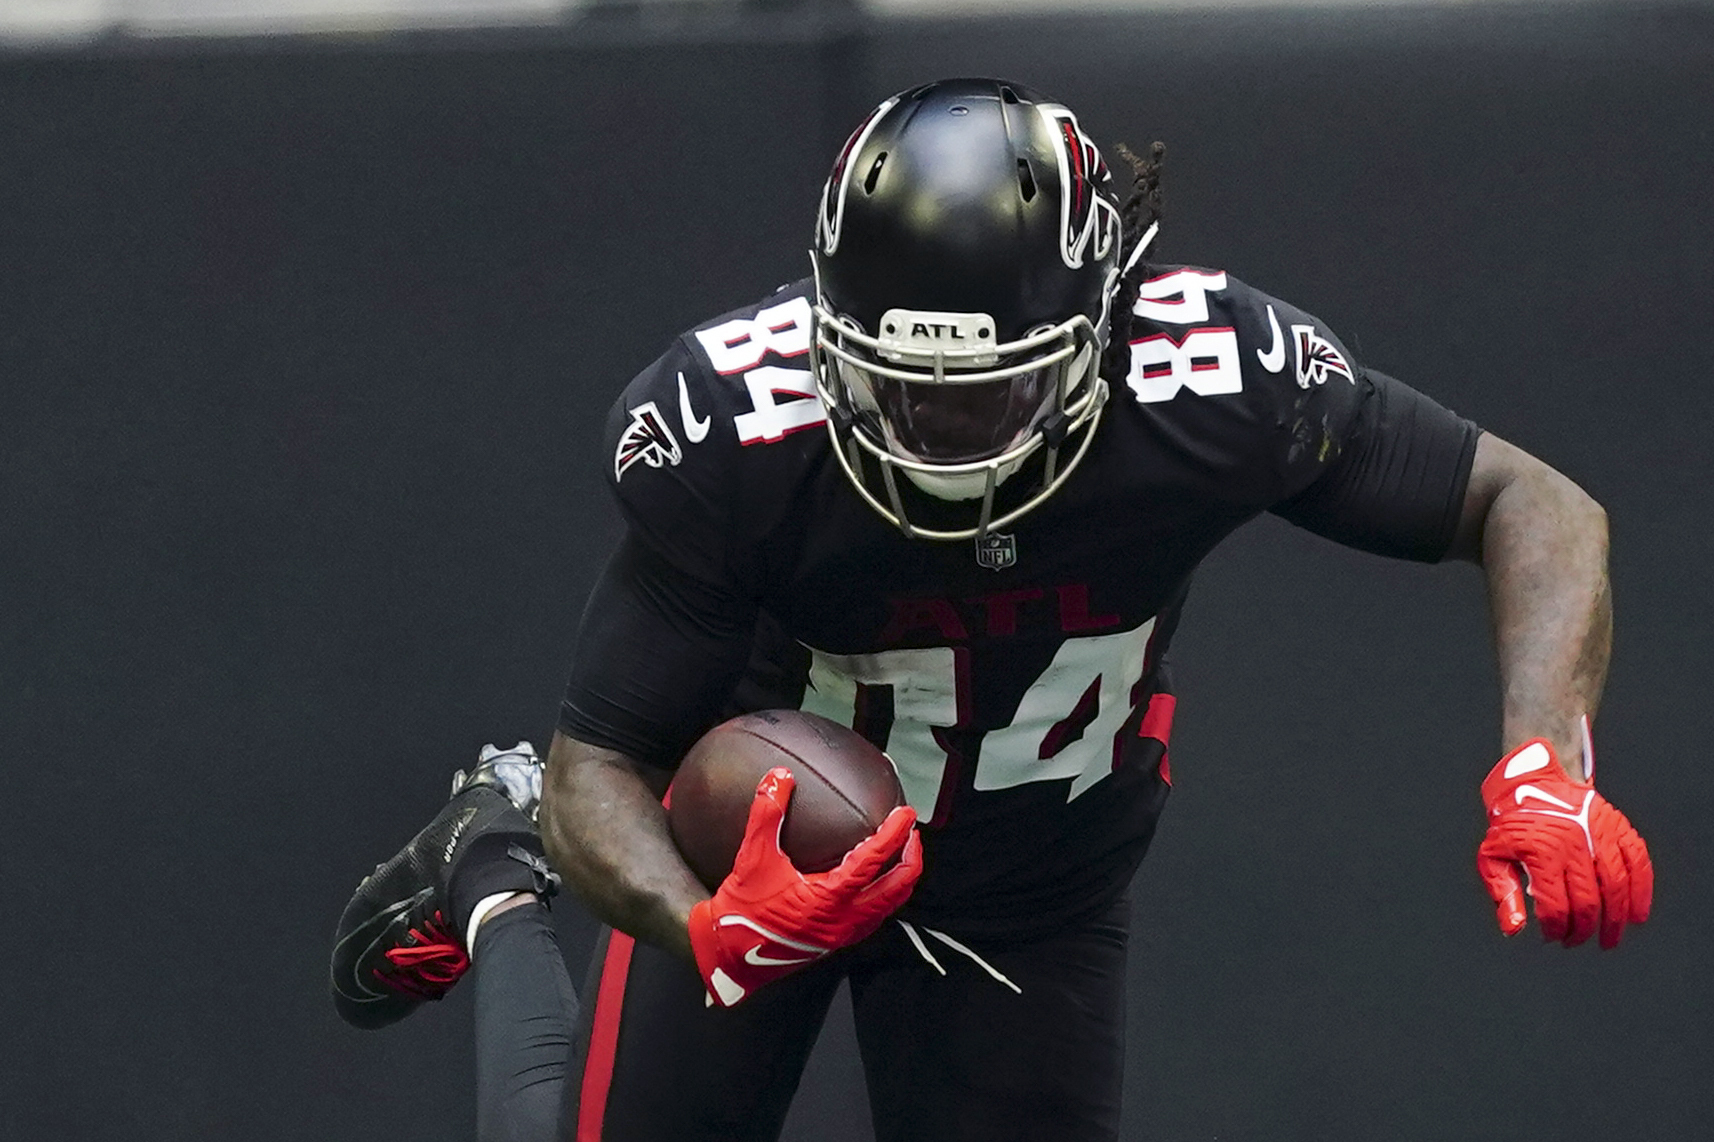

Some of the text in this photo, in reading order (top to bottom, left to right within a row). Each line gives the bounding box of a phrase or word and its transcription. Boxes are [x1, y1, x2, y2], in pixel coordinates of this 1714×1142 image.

[910, 322, 965, 339] ATL
[1126, 267, 1243, 404] 84
[695, 296, 828, 447] 84
[876, 584, 1121, 643] ATL
[443, 821, 465, 863] VAPOR
